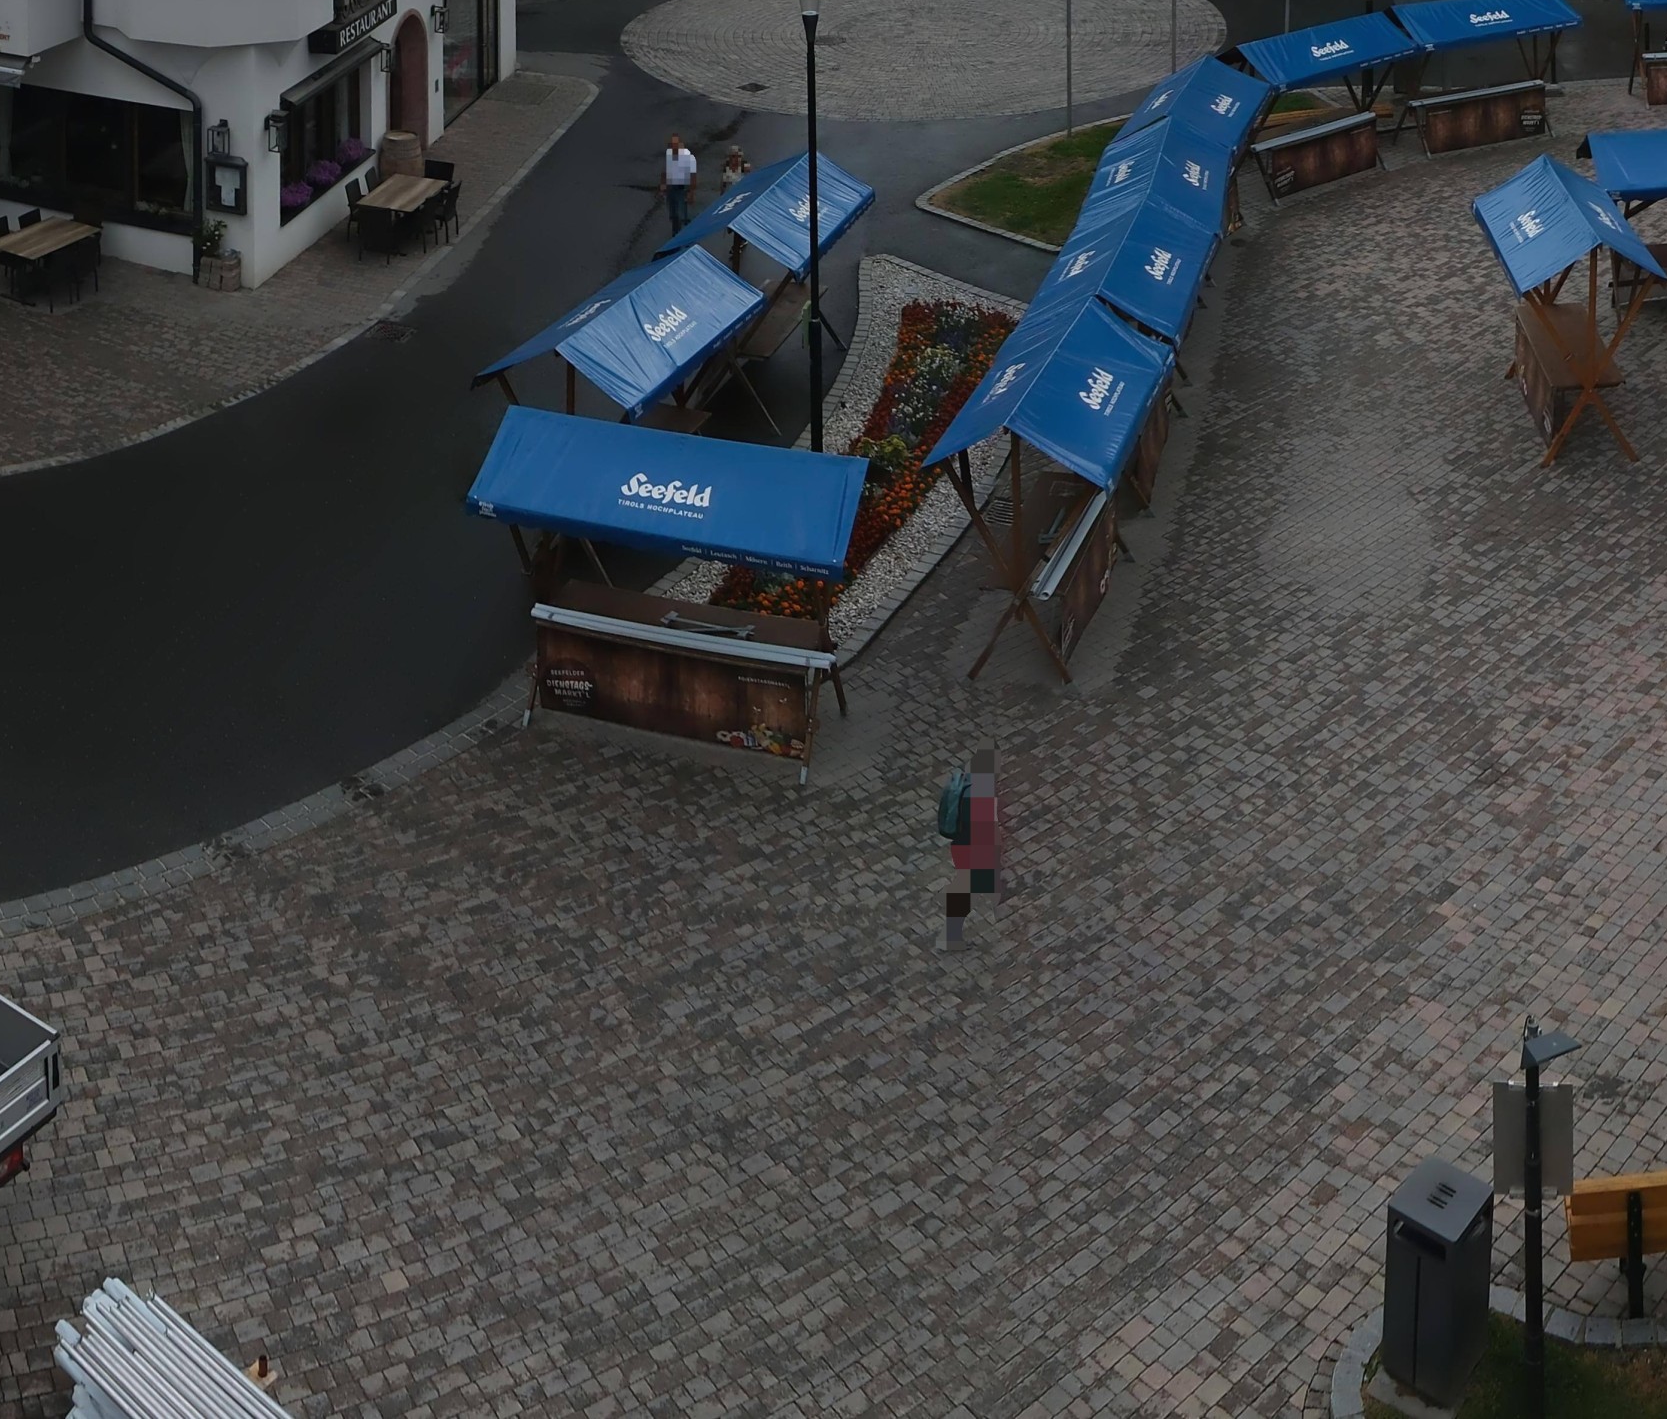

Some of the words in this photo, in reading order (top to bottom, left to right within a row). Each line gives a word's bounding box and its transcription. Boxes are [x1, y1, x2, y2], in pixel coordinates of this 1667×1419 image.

[1469, 9, 1510, 24] Seefeld
[1311, 39, 1349, 57] Seefeld
[1144, 247, 1172, 281] Seefeld
[644, 304, 688, 342] Seefeld
[1078, 366, 1114, 410] Seefeld
[620, 472, 712, 508] Seefeld
[618, 498, 645, 509] TIROLS
[647, 503, 704, 520] HOCHPLATEAU
